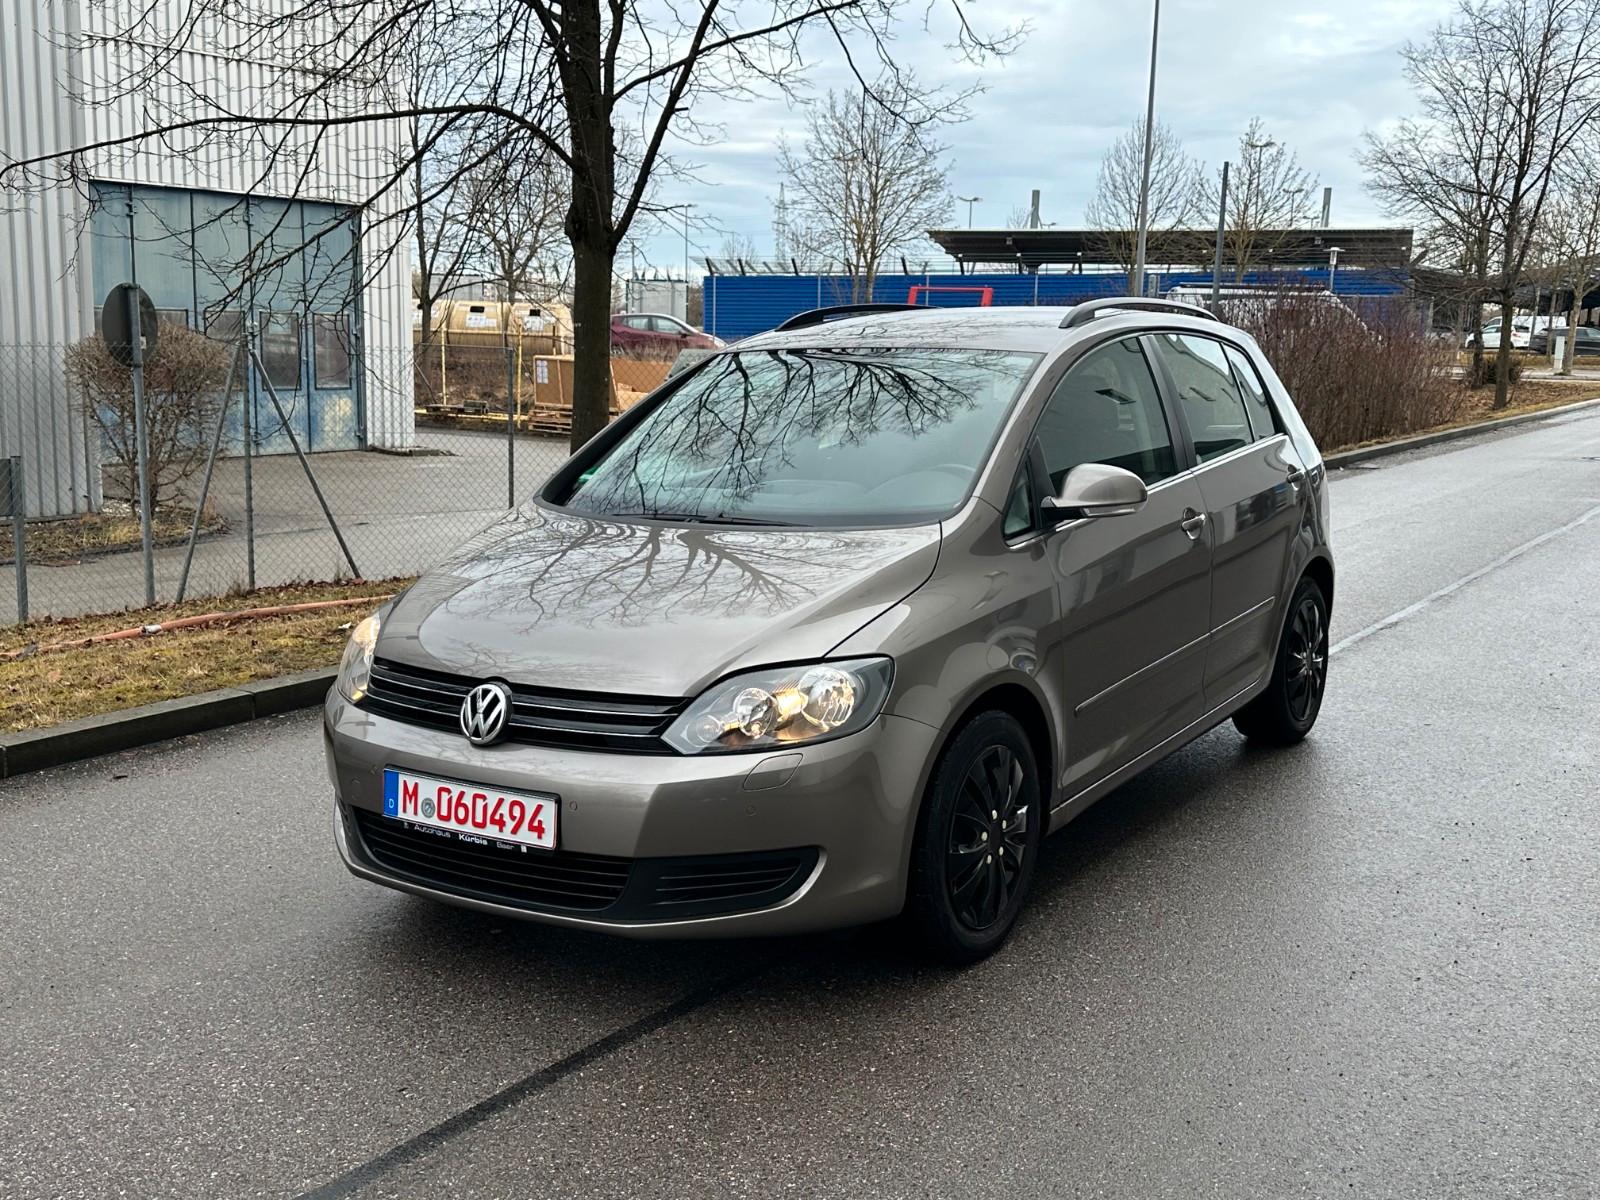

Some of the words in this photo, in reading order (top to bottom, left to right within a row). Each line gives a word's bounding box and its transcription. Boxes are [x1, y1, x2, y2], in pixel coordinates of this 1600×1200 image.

[461, 683, 506, 743] VW
[388, 798, 395, 809] D
[402, 779, 419, 816] M
[436, 786, 545, 840] 060494
[414, 824, 451, 838] Autohaus
